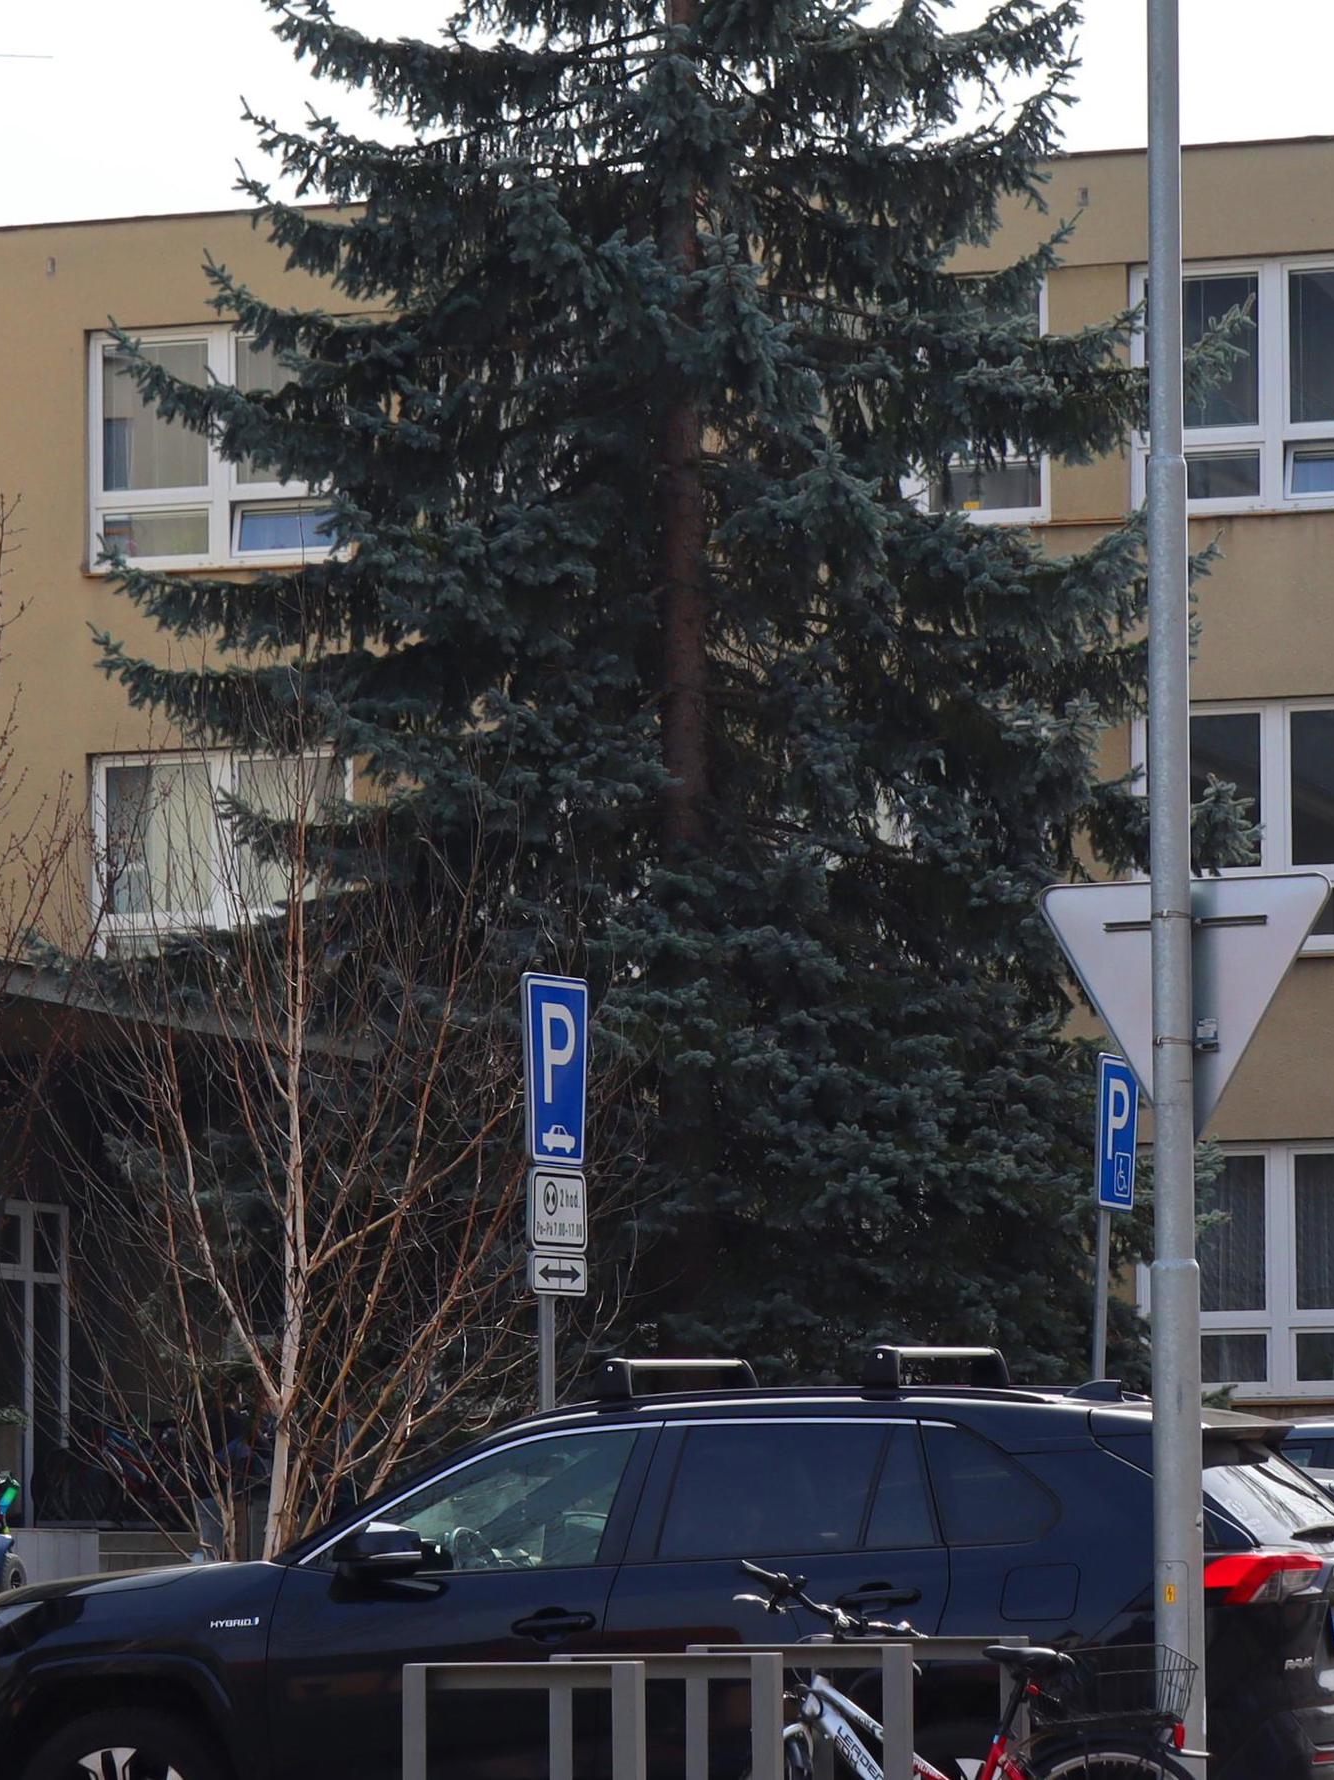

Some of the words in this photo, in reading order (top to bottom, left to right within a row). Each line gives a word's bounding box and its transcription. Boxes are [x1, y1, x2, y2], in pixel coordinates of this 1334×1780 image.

[541, 1001, 576, 1104] P
[1107, 1078, 1130, 1160] P
[559, 1189, 564, 1208] 2
[210, 1618, 252, 1629] HYBRID
